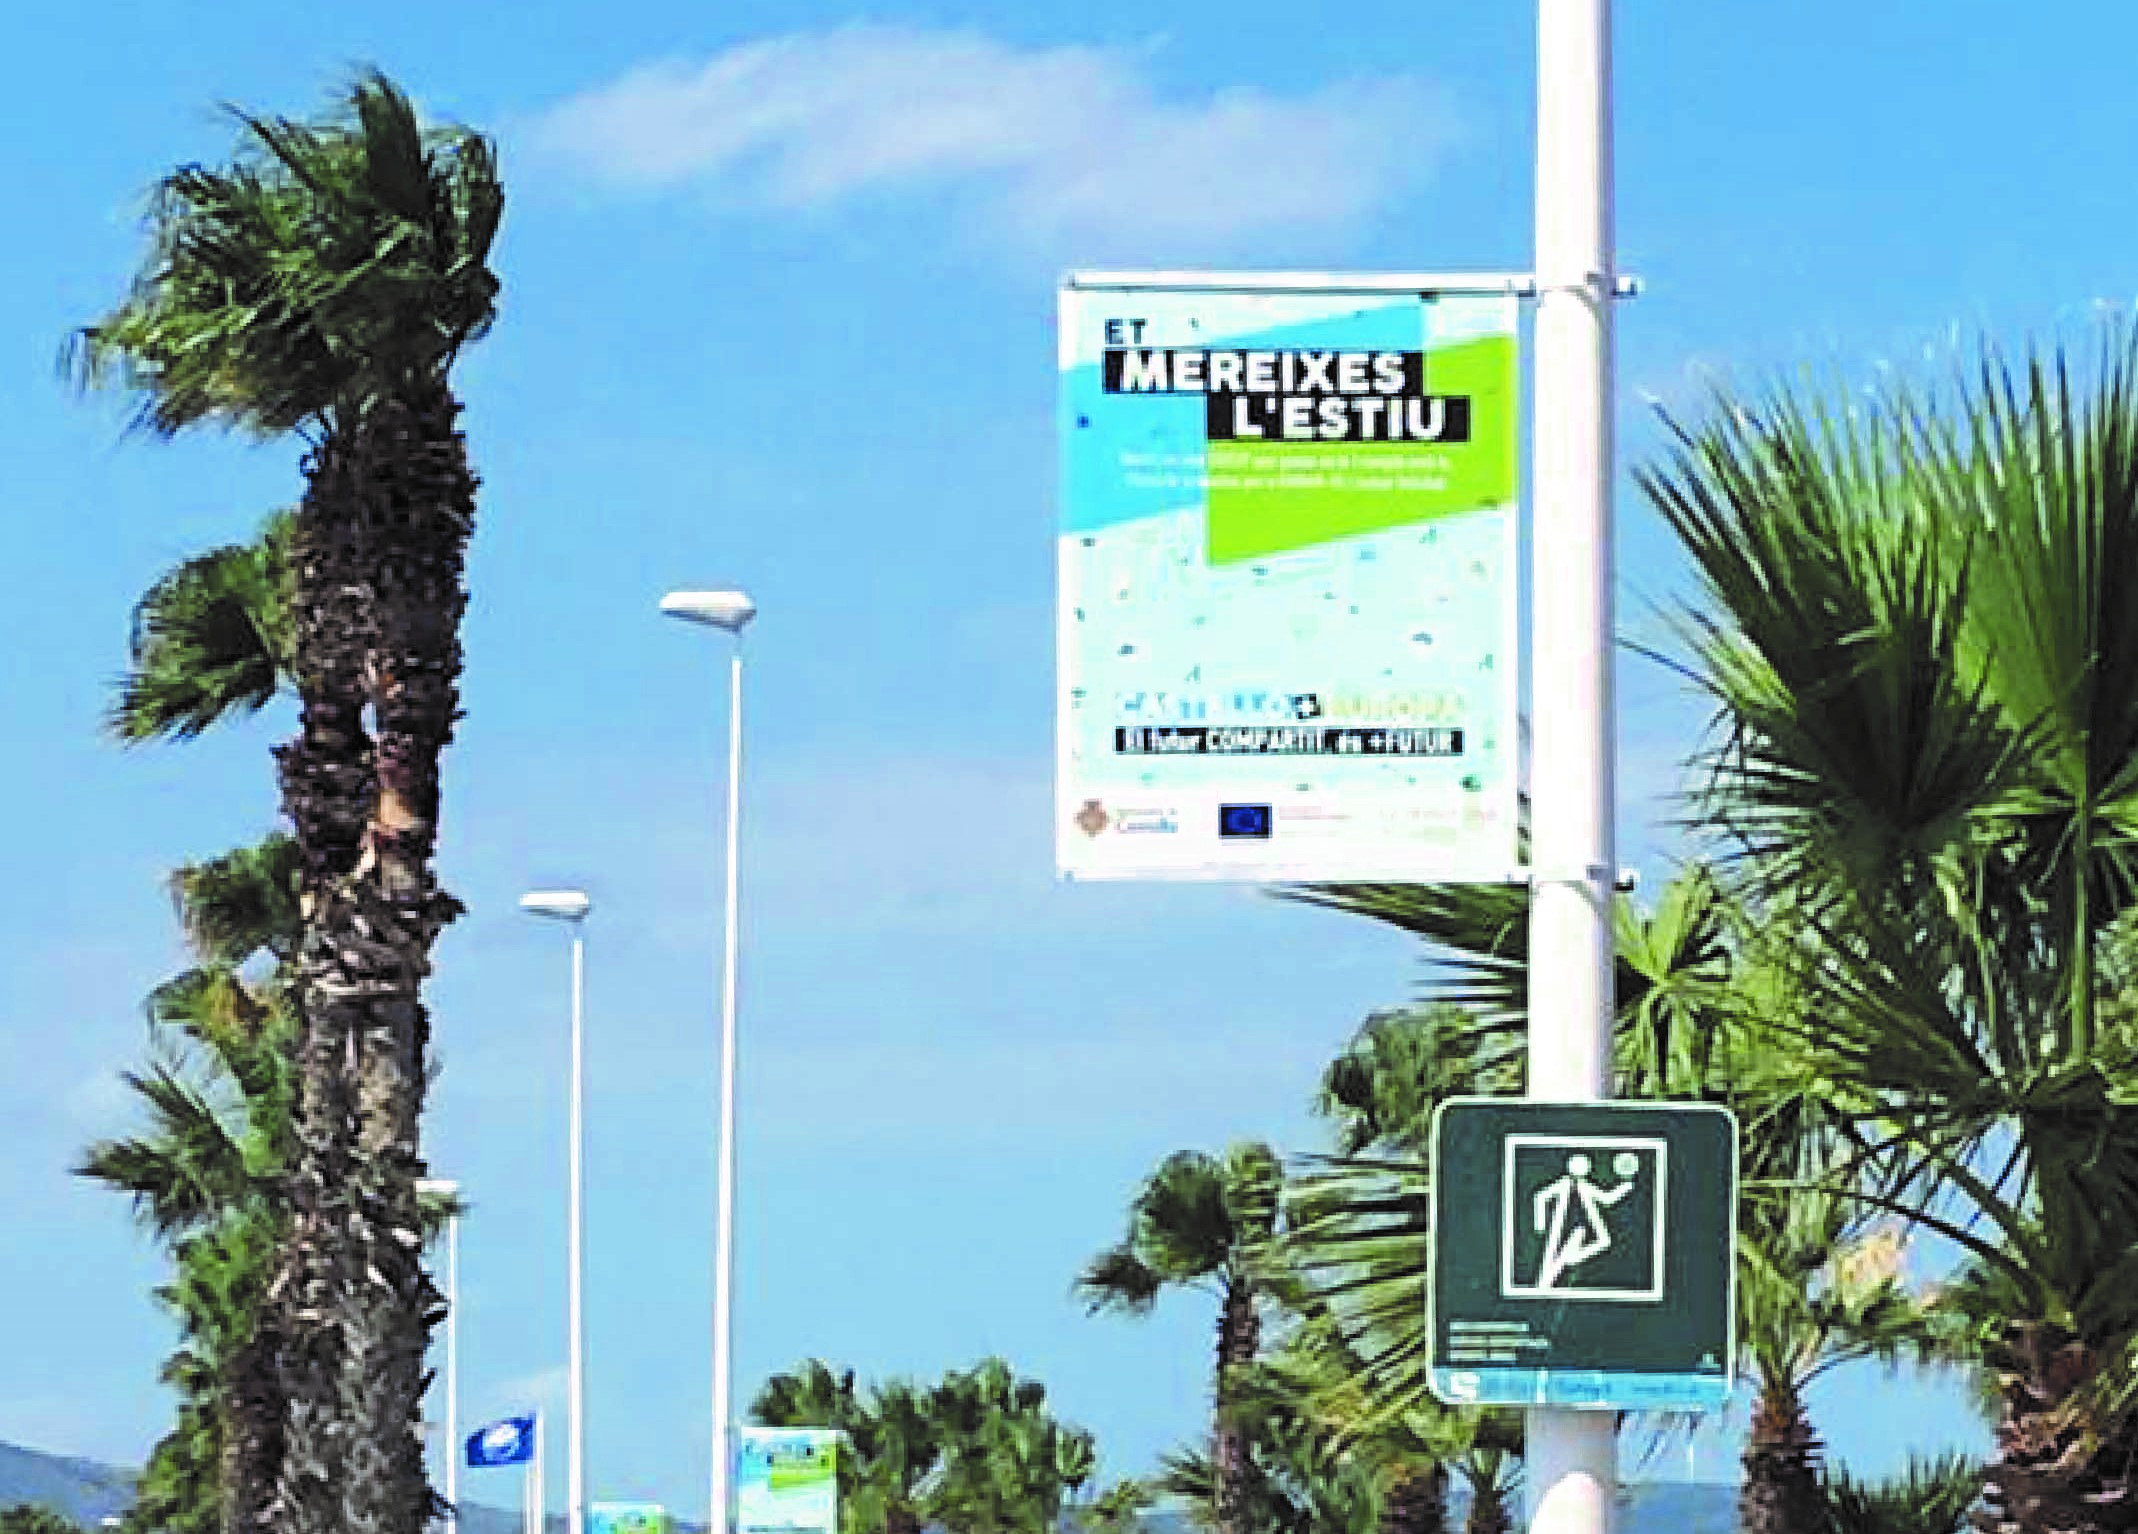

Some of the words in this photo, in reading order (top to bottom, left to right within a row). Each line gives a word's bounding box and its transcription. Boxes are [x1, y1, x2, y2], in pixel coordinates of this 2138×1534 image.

[1104, 318, 1148, 345] ET
[1121, 349, 1407, 392] MEREIXES
[1233, 396, 1445, 440] L'ESTIU
[1206, 730, 1326, 753] COMPARTIT
